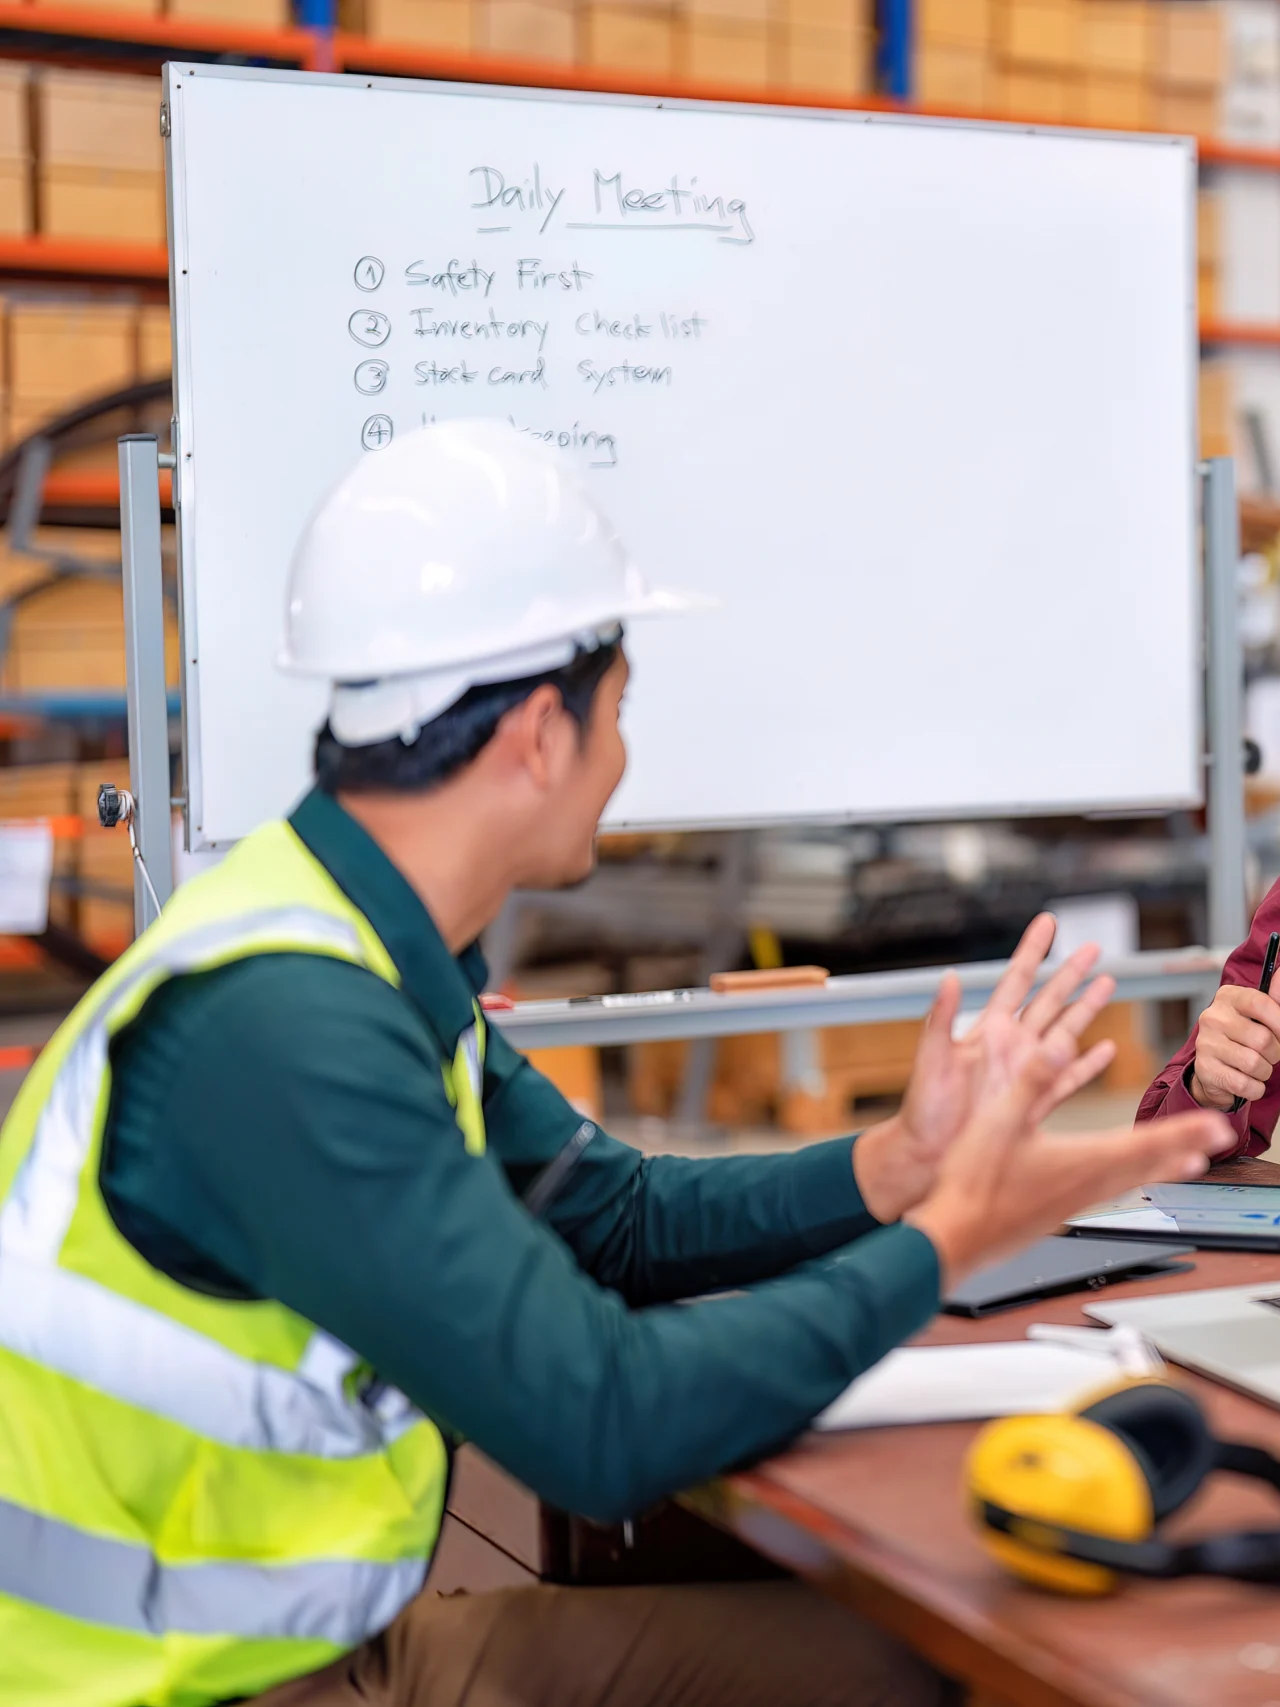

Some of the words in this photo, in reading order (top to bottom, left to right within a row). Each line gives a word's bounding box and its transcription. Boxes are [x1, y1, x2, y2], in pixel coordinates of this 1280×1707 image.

[469, 162, 565, 234] Daily
[592, 167, 755, 244] Meeting
[404, 259, 496, 298] Safety
[516, 258, 595, 292] First
[409, 307, 549, 352] Inventory
[414, 359, 478, 386] Stock
[576, 359, 672, 394] System
